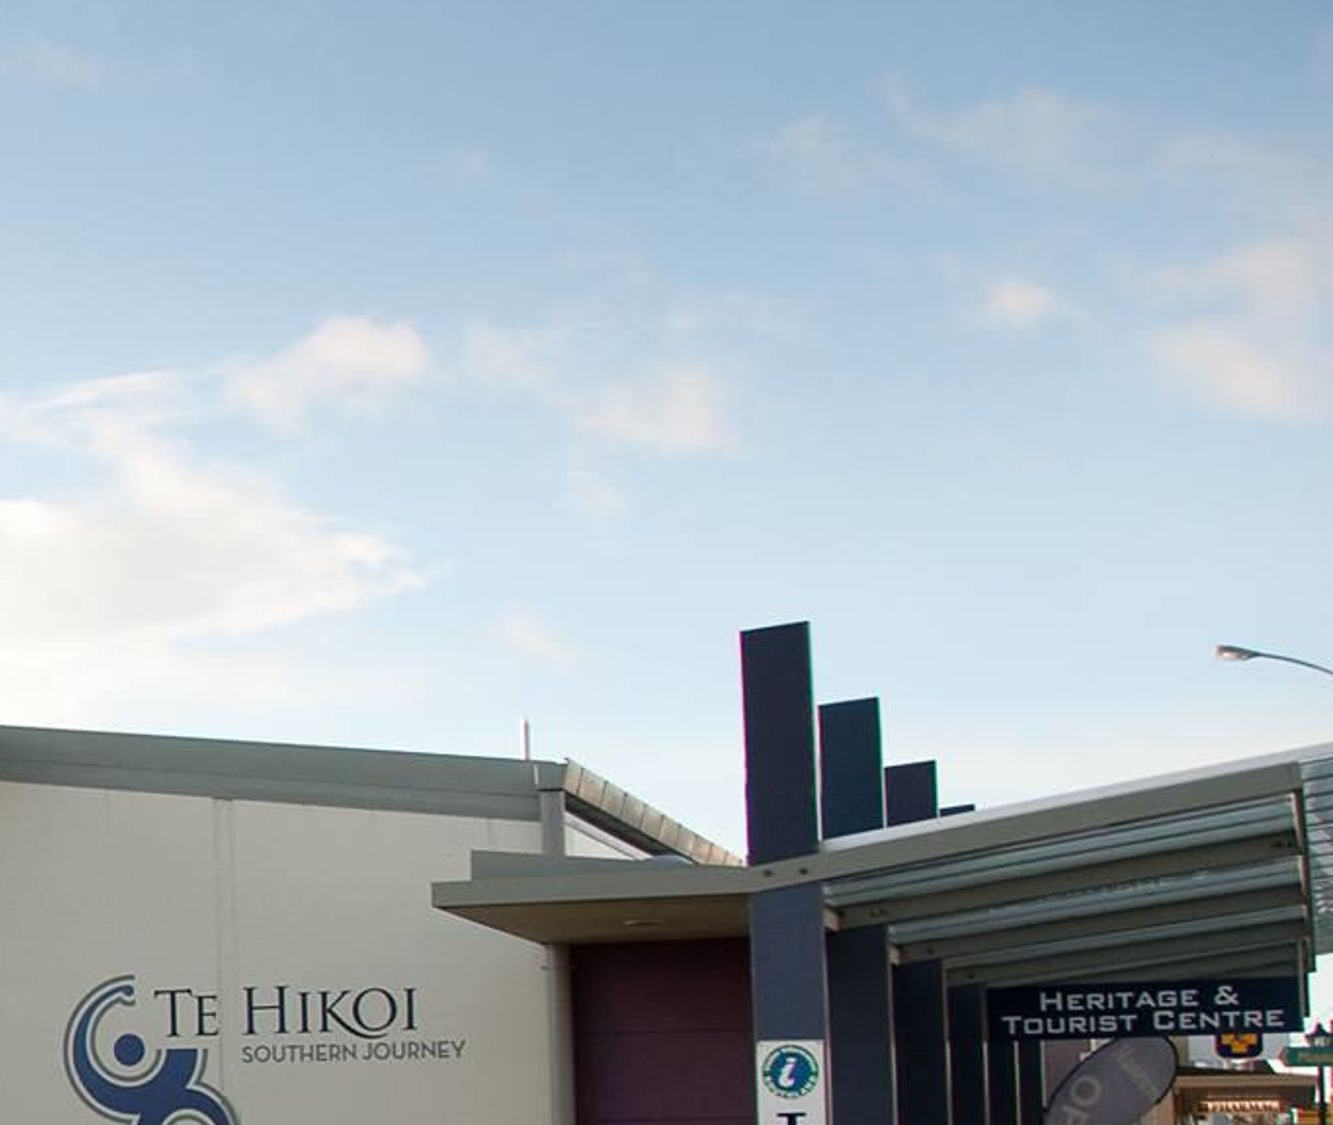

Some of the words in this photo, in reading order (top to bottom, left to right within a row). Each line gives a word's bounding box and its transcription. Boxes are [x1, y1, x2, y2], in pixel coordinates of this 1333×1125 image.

[1040, 989, 1199, 1012] HERITAGE
[1214, 985, 1239, 1006] &
[1001, 1014, 1137, 1036] TOURIST
[1152, 1009, 1284, 1031] CENTRE
[242, 1044, 357, 1064] SOUTHERN
[362, 1039, 466, 1061] JOURNEY
